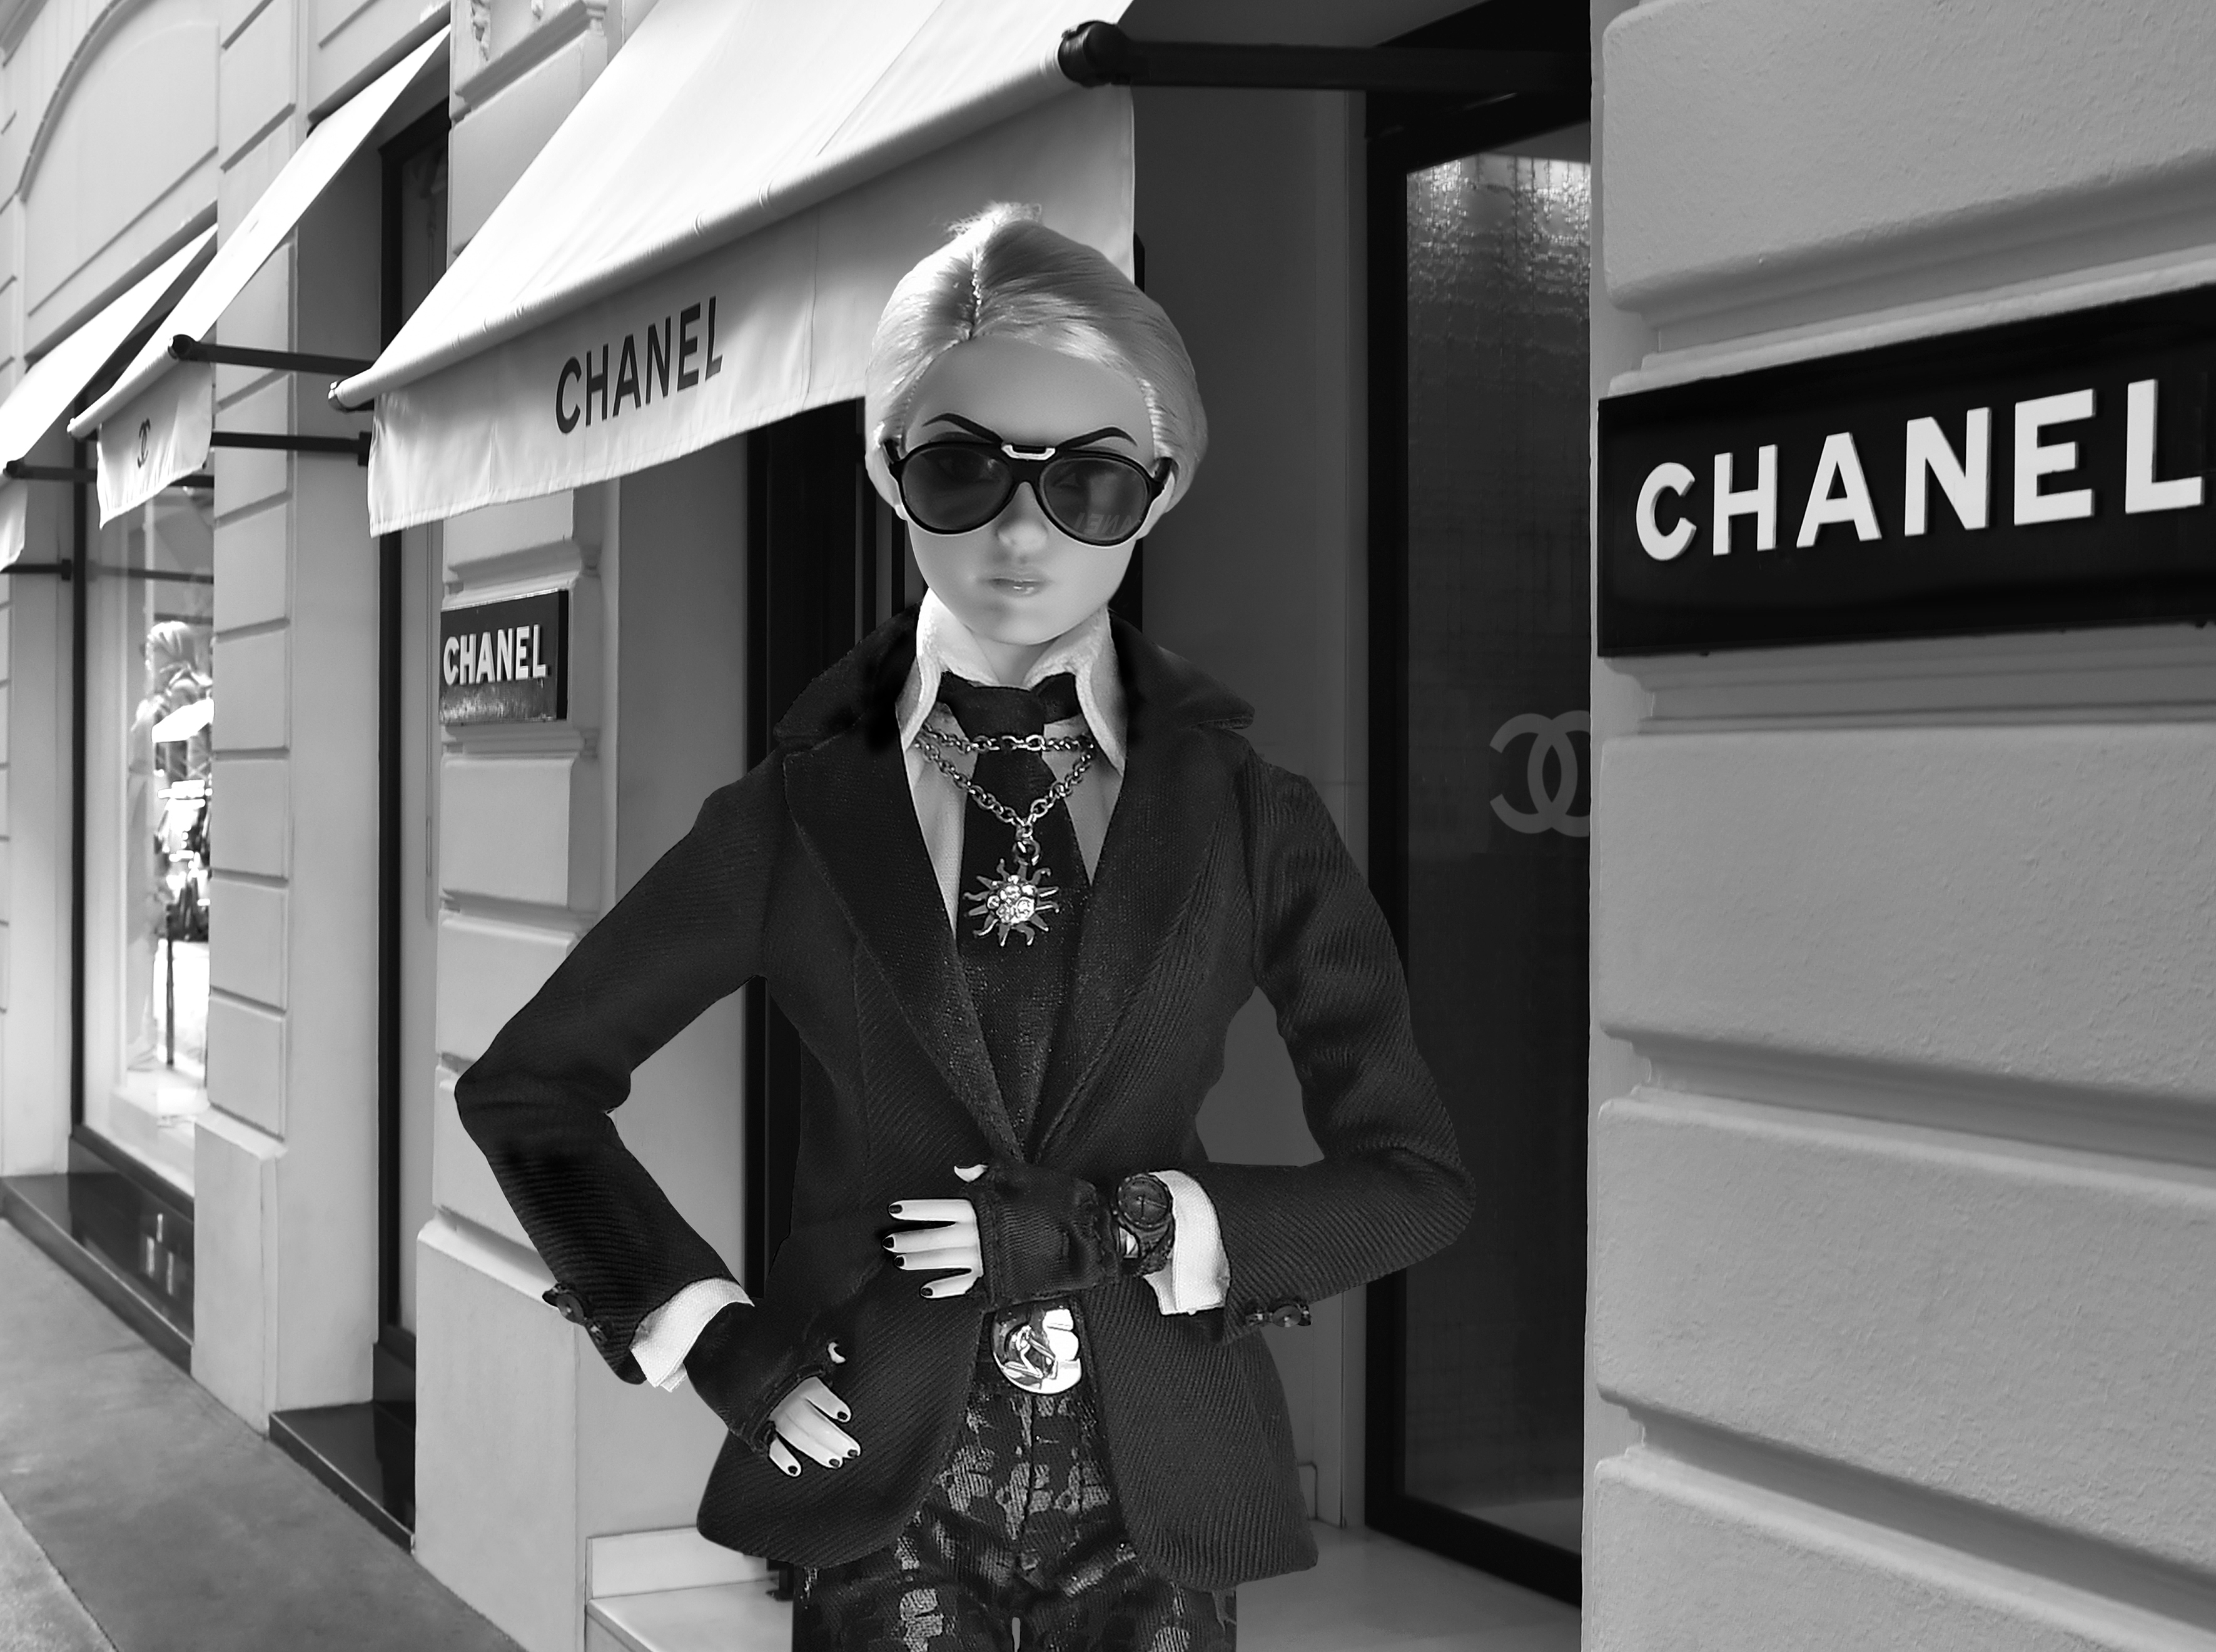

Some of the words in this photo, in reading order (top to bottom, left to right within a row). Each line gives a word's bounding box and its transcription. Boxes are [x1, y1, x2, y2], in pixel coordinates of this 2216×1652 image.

[555, 296, 723, 434] CHANEL
[1636, 379, 2205, 561] CHANEL
[443, 624, 546, 685] CHANEL
